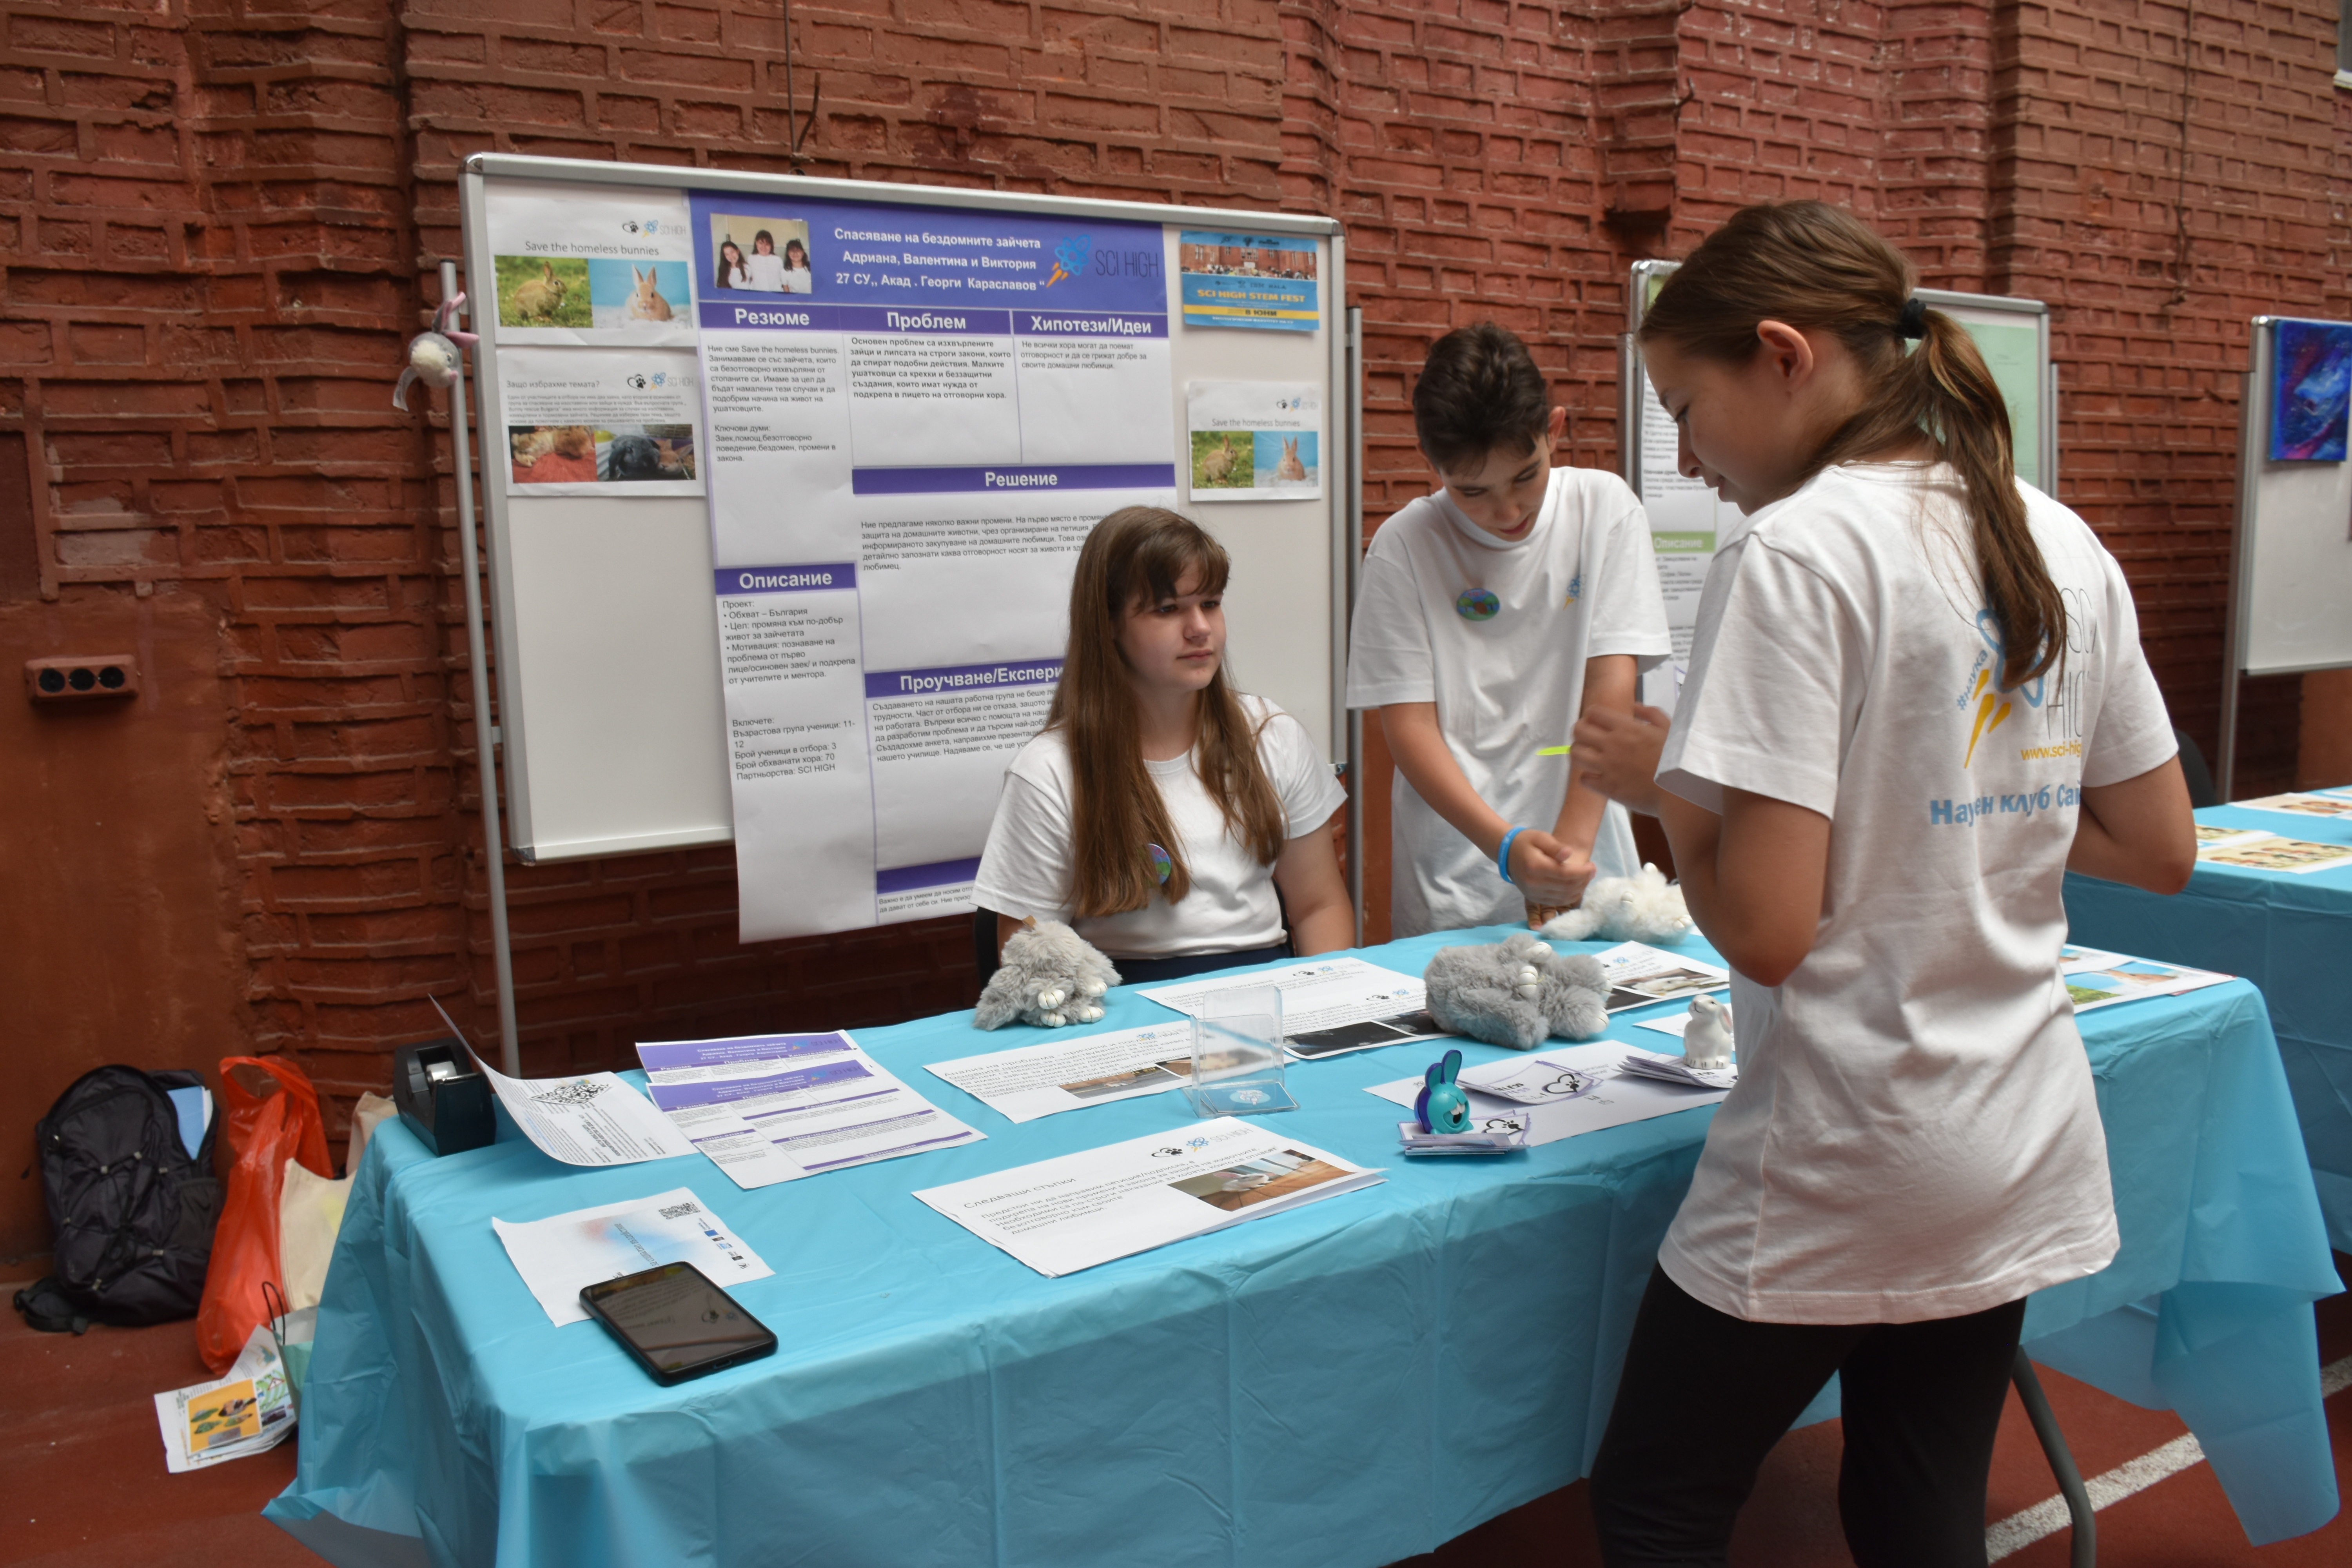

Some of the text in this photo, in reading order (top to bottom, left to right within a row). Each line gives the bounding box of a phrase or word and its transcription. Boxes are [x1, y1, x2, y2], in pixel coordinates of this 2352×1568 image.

[834, 227, 1041, 249] Спасяване на бездомните зайчета
[525, 241, 659, 256] Save the homeless bunnies
[843, 250, 1036, 271] Адриана, Валентина и Виктория
[1095, 249, 1159, 280] SCI HIGH
[836, 272, 1036, 291] 27 СУ,, Акад Георги Караславов
[1218, 291, 1247, 299] HIGH
[1249, 292, 1279, 301] STEM
[1281, 294, 1305, 303] FEST
[735, 308, 809, 326] Резюме
[887, 312, 966, 333] Проблем
[1031, 316, 1151, 335] Хипотези/Идеи
[889, 338, 925, 347] проблем
[506, 380, 527, 389] Защо
[529, 380, 567, 388] избрахме
[1212, 418, 1228, 427] Save
[1242, 419, 1274, 427] homeless
[1275, 419, 1301, 427] bunnies
[985, 472, 1058, 487] Решение
[1654, 537, 1703, 549] Описание
[739, 573, 832, 589] Описание
[722, 601, 754, 610] Проект:
[729, 609, 808, 619] Обхват България
[730, 622, 749, 631] Цел:
[751, 621, 787, 630] промяна
[806, 616, 844, 625] по-добър
[764, 630, 804, 639] зайчетата
[732, 642, 779, 652] Мотивация:
[782, 640, 824, 648] познаване
[727, 653, 768, 664] проблема
[728, 664, 789, 673] лице/осиновен
[791, 660, 811, 669] заек/
[819, 659, 856, 667] подкрепа
[740, 675, 782, 685] учителите
[900, 667, 1063, 694] Проучване/Експери
[873, 701, 923, 711] Създаването
[965, 695, 994, 704] работна
[732, 718, 774, 727] Включете:
[733, 728, 781, 738] Възрастова
[782, 726, 804, 734] група
[806, 722, 840, 733] ученици:
[735, 750, 755, 760] Брой
[757, 748, 791, 759] ученици
[799, 744, 829, 753] отбора:
[2020, 740, 2082, 760] www.sci-hig
[736, 761, 757, 771] Брой
[758, 758, 800, 768] обхванати
[737, 763, 835, 780] Партньорства: SCI HIGH
[2000, 784, 2051, 817] клуб
[964, 1178, 1076, 1209] Следващи стъпки
[981, 1203, 1029, 1219] Предстои
[1058, 1185, 1104, 1200] направим
[1105, 1163, 1188, 1187] петиция/подписка,
[1002, 1210, 1070, 1231] безотговорно
[1092, 1196, 1124, 1207] своите
[1011, 1206, 1106, 1235] домашни любимци.
